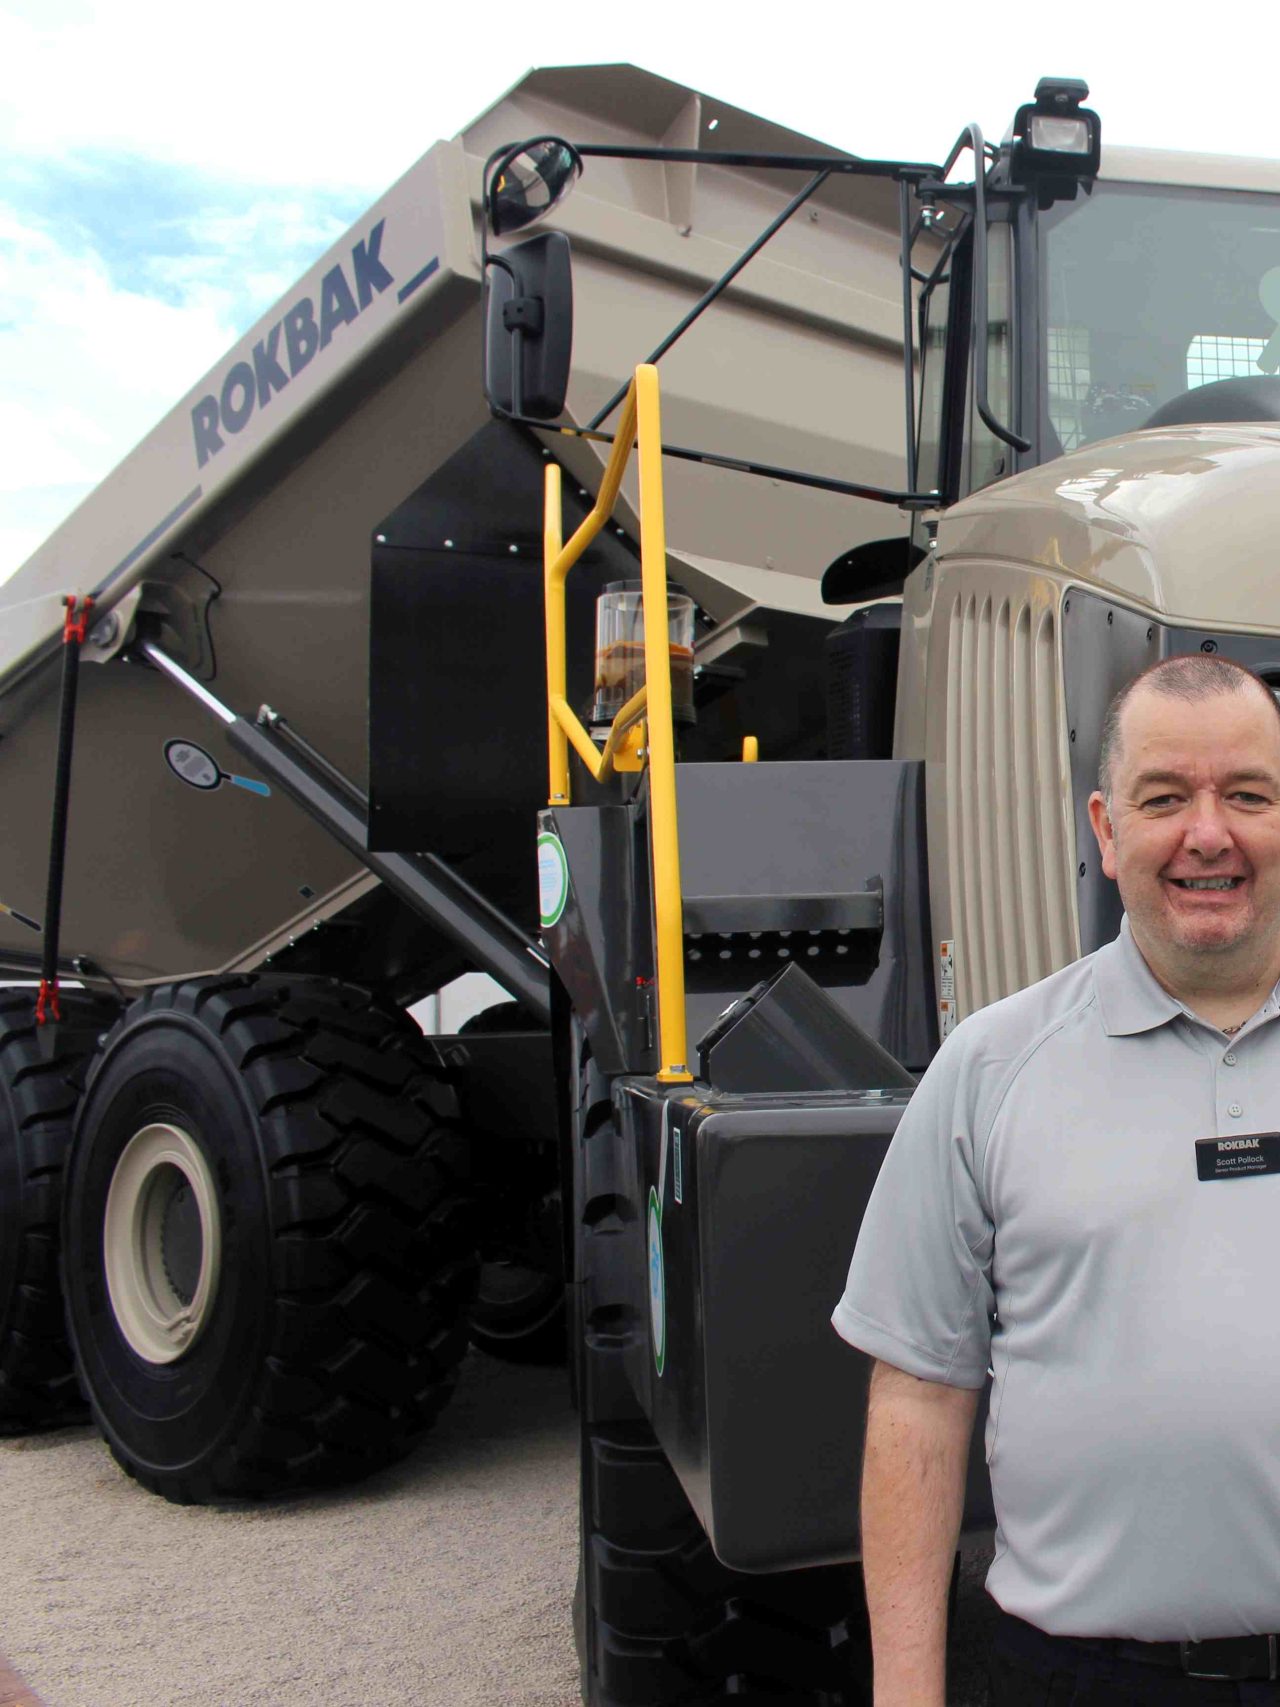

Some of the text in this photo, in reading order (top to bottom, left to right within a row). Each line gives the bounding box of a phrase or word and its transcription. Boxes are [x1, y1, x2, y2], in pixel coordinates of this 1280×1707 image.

[191, 217, 394, 469] ROKBAK
[1217, 1138, 1260, 1151] ROKBAK
[1216, 1155, 1265, 1166] Scott Pollock
